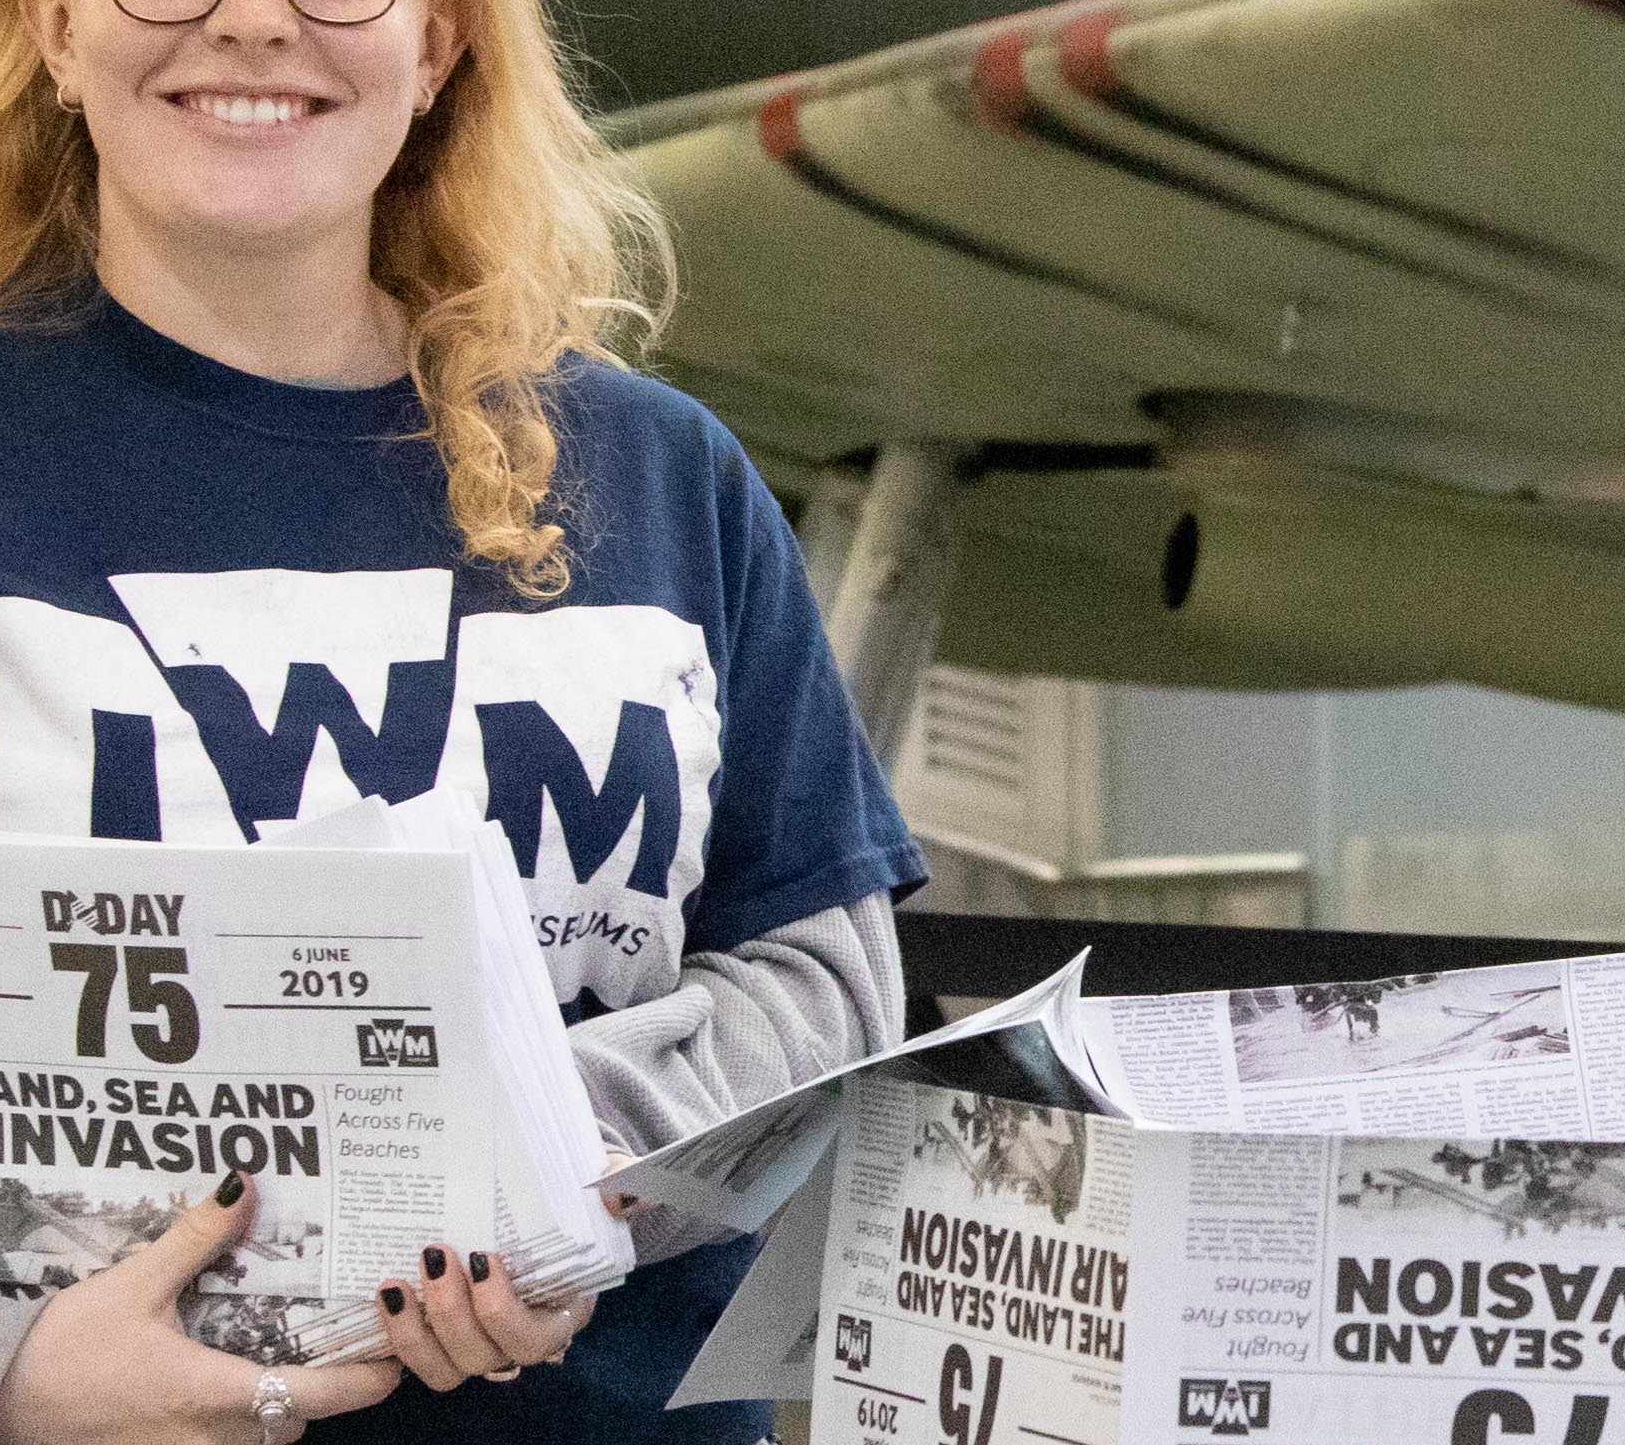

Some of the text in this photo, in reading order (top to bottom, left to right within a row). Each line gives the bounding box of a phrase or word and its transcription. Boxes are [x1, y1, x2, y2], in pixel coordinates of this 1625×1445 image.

[91, 659, 679, 900] IWM
[530, 911, 650, 955] SEUMS
[291, 947, 352, 965] 6 JUNE
[50, 941, 201, 1065] 75
[279, 969, 370, 999] 2019
[106, 1078, 200, 1118] SEA
[209, 1082, 315, 1119] AND
[334, 1083, 403, 1105] Fought
[336, 1112, 445, 1132] Across Five
[340, 1138, 421, 1159] Beaches
[900, 1207, 1128, 1313] AIR INVASION
[1214, 1277, 1312, 1300] Beaches
[897, 1270, 1126, 1363] THE LAND, SEA AND
[1181, 1307, 1311, 1329] Across Five
[1226, 1336, 1310, 1362] Fought
[1333, 1322, 1459, 1365] AND
[1470, 1325, 1585, 1371] SEA
[857, 1397, 898, 1435] 2019
